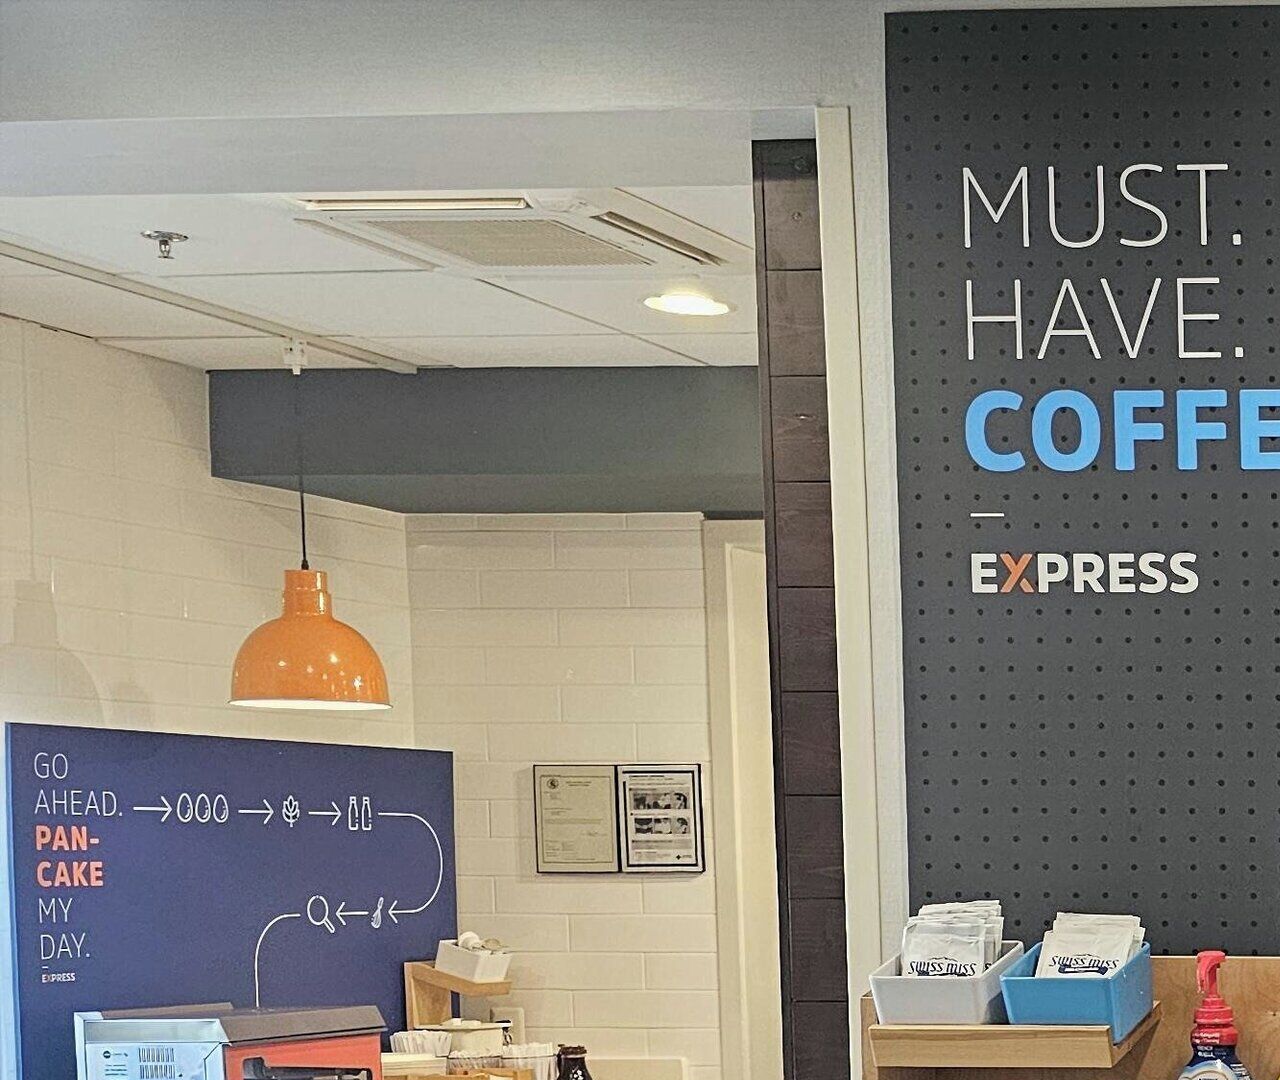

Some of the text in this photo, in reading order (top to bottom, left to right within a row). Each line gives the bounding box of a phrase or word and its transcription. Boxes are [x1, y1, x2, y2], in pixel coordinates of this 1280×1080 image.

[963, 164, 1241, 248] MUST.
[967, 278, 1244, 360] HAVE.
[970, 552, 1198, 593] EXPRESS
[34, 752, 69, 780] GO
[34, 789, 123, 817] AHEAD.
[35, 825, 100, 851] PAN-
[36, 862, 104, 887] CAKE
[39, 898, 73, 923] MY
[40, 933, 91, 960] DAY.
[42, 973, 76, 983] EXPRESS
